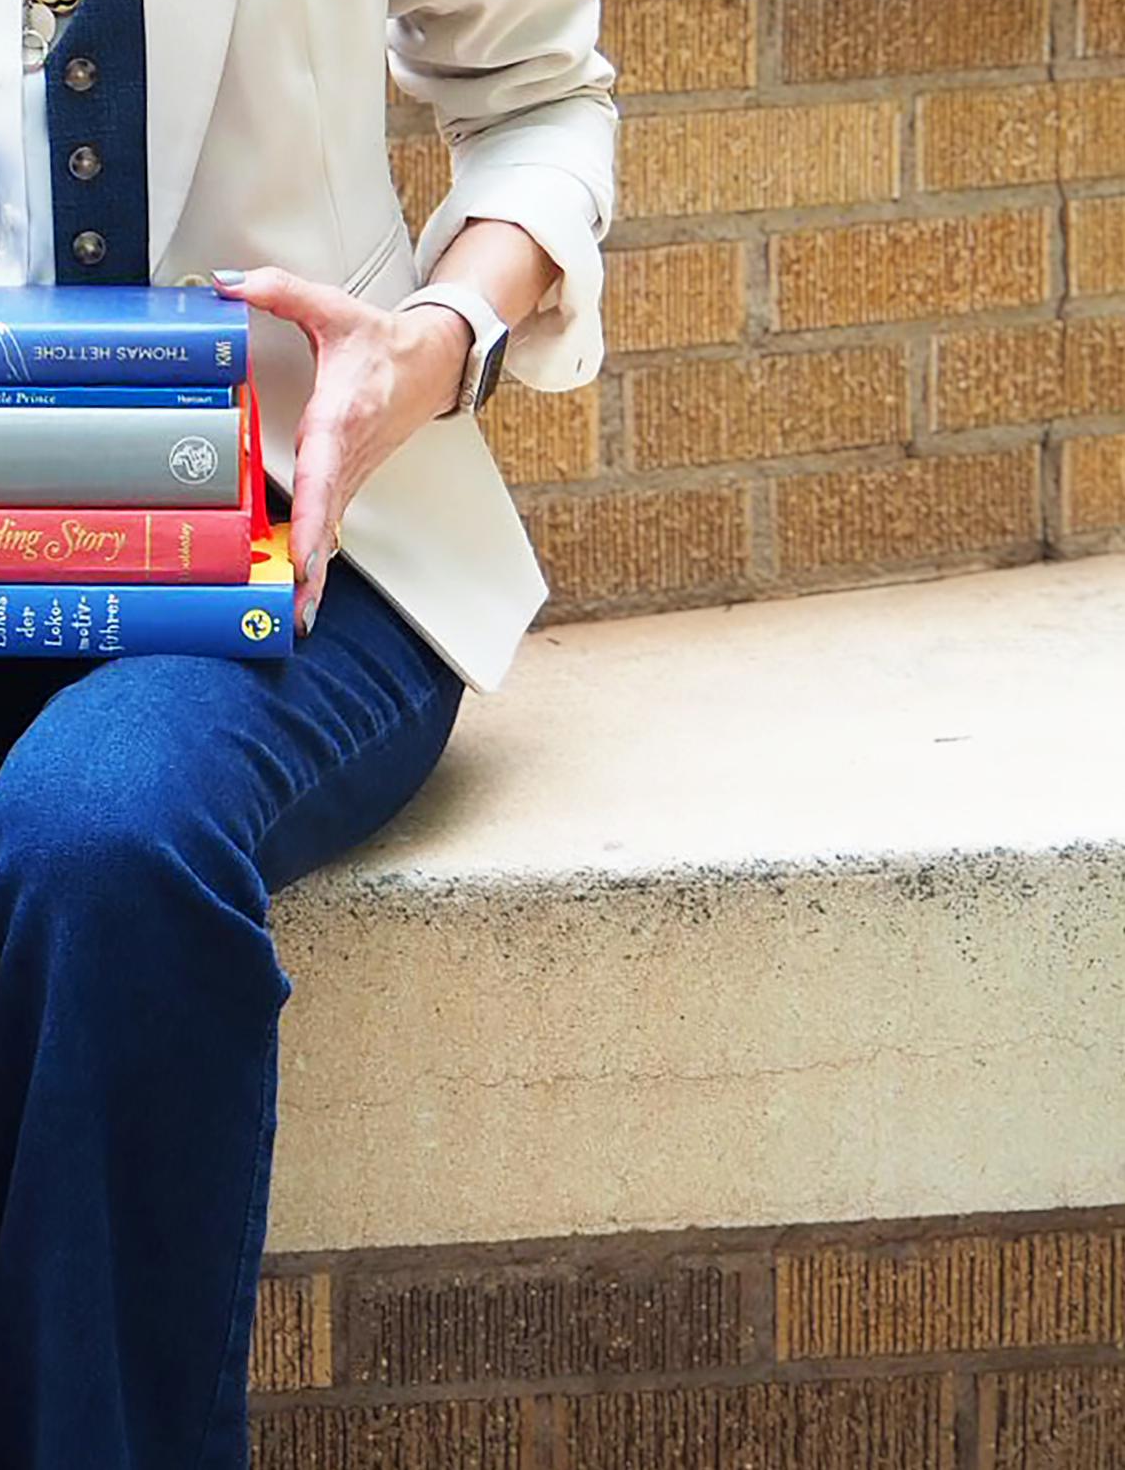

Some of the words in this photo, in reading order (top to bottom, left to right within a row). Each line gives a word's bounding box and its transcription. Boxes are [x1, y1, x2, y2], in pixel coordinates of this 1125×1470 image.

[34, 346, 111, 361] HETTCHE
[117, 346, 189, 361] THOMAS
[16, 391, 56, 403] Prince
[43, 520, 127, 561] Story
[15, 606, 36, 638] der
[44, 598, 63, 647] Loko-
[71, 595, 91, 651] motiv-
